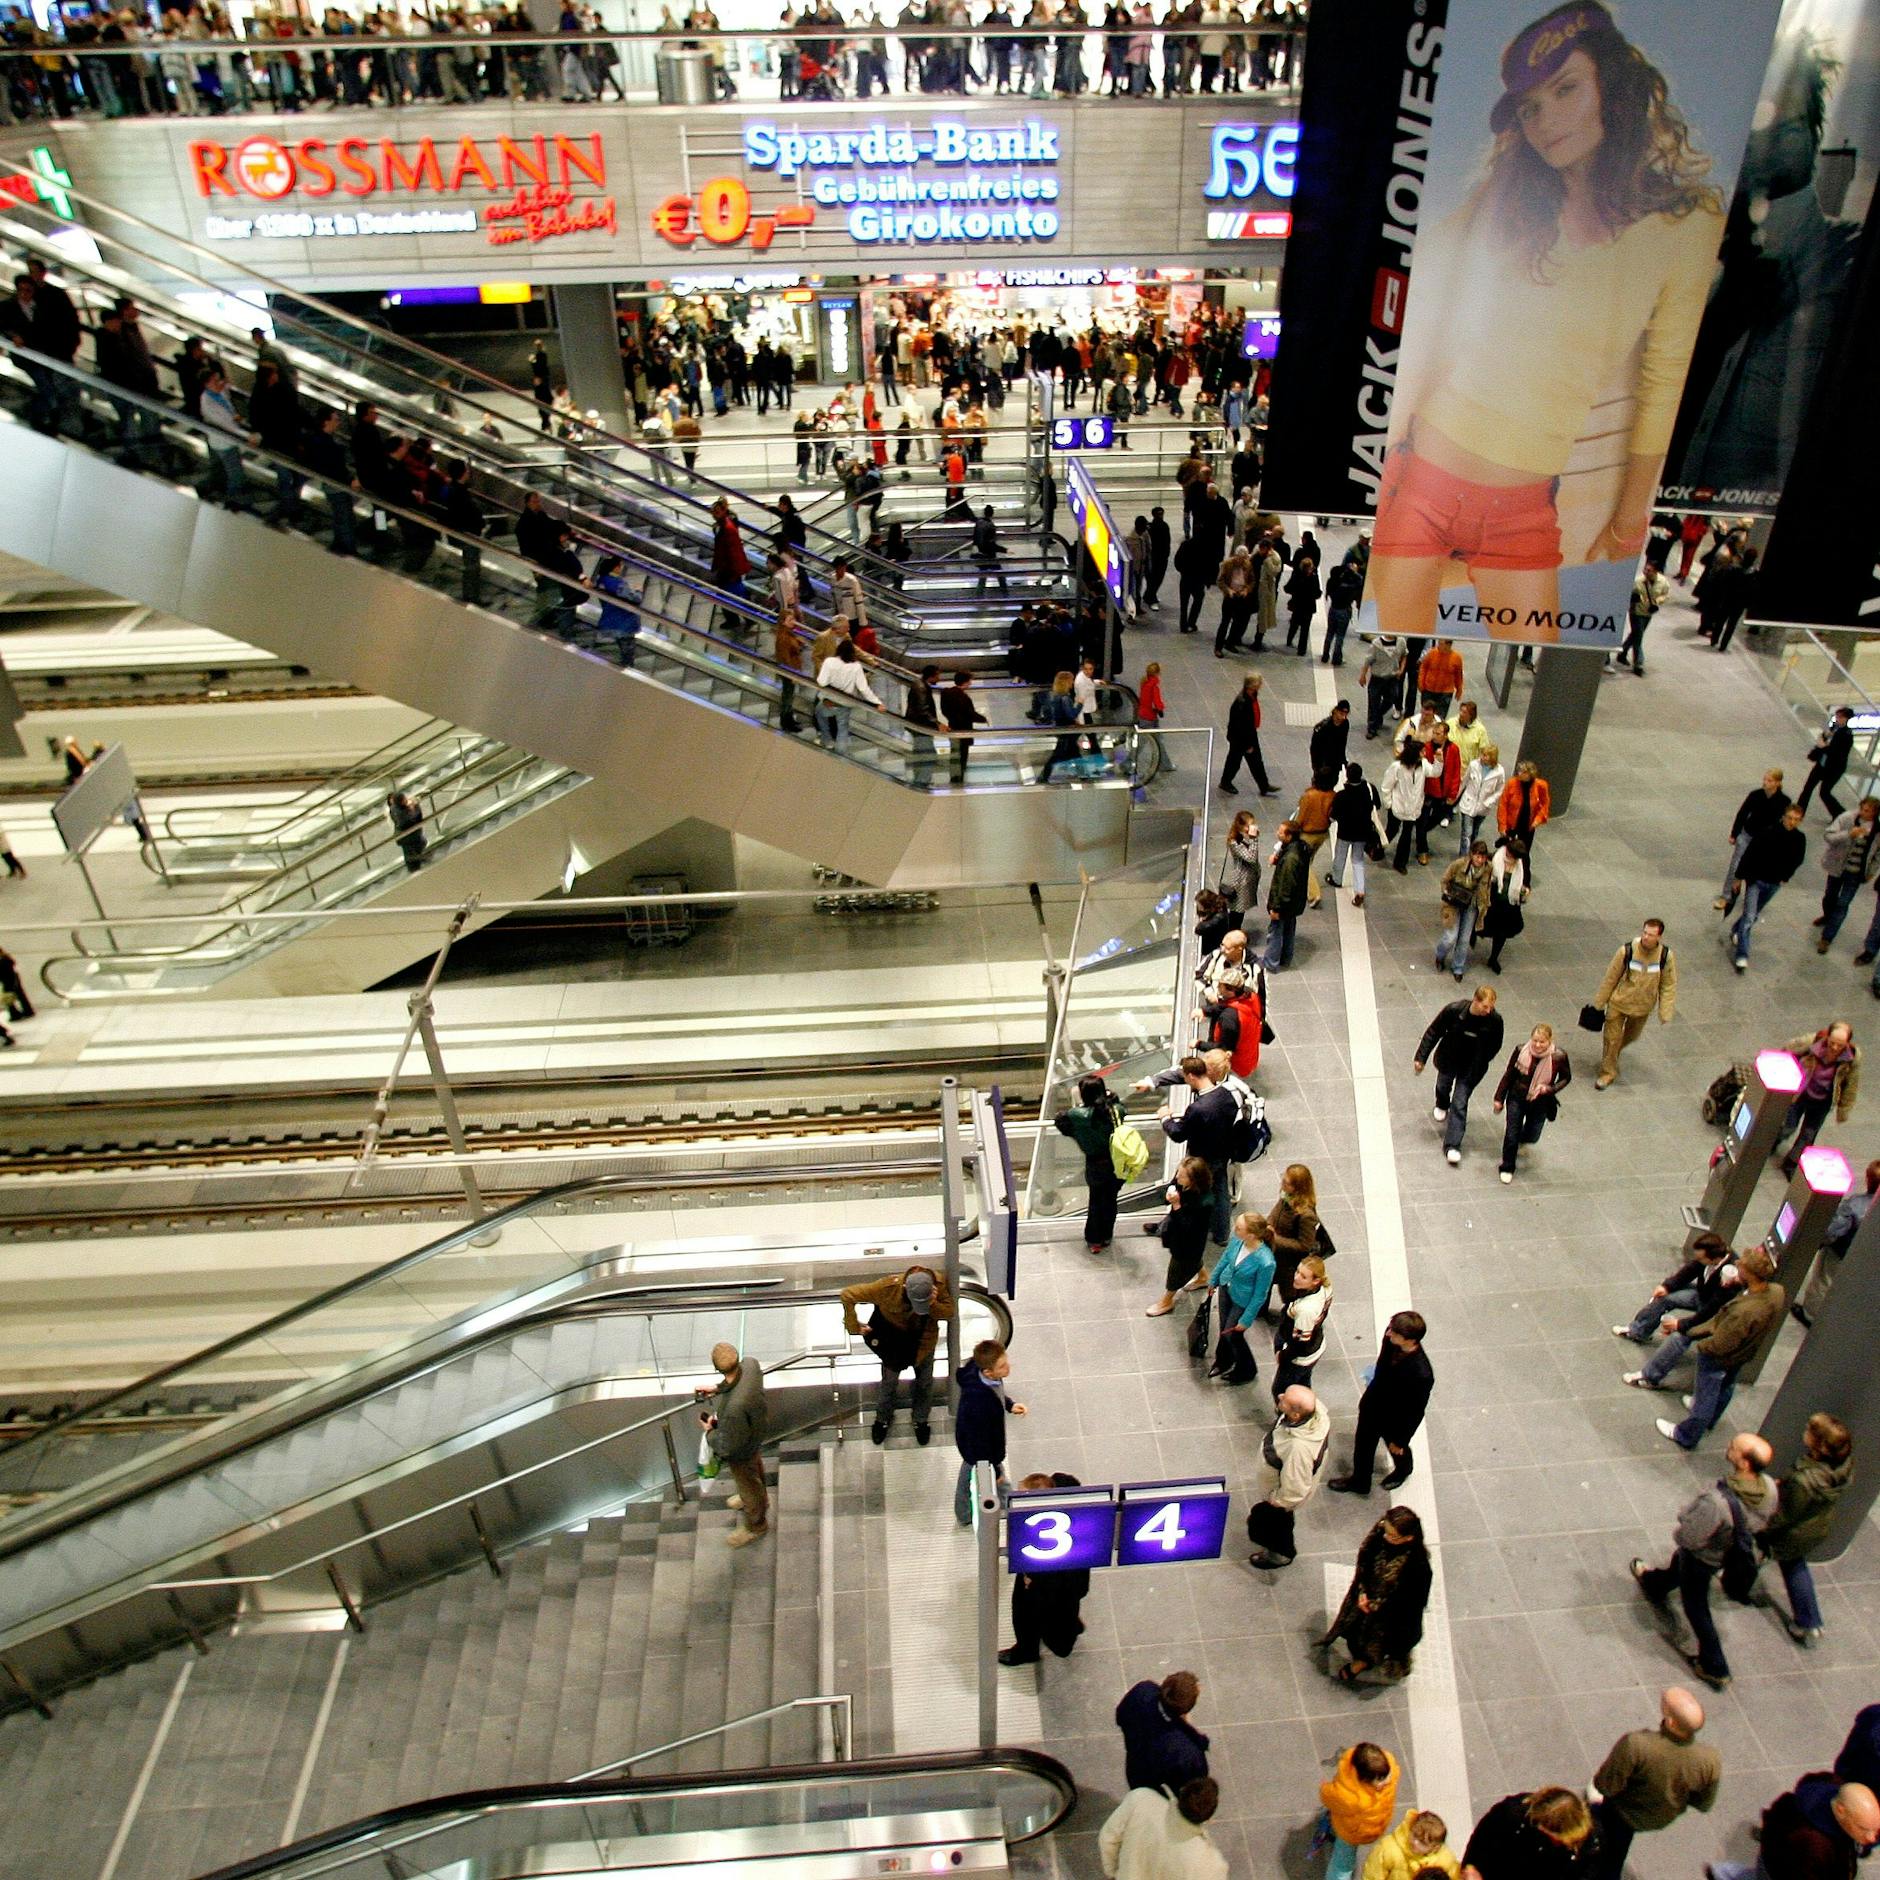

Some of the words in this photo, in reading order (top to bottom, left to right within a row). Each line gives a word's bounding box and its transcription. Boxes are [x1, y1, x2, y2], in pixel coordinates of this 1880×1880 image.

[187, 132, 608, 200] ROSSMANN
[744, 121, 1060, 176] Sparda-Bank
[813, 175, 1059, 205] Gebührenfreies
[524, 196, 617, 243] Bahnhof
[848, 205, 1059, 241] Girokonto
[1348, 335, 1401, 507] JACK
[1382, 21, 1446, 268] JONES
[1054, 419, 1073, 445] 5
[1085, 418, 1105, 445] 6
[1712, 489, 1780, 505] JONES
[1438, 604, 1517, 626] VERO
[1525, 610, 1617, 633] MODA
[1021, 1511, 1073, 1560] 3
[1134, 1502, 1186, 1550] 4
